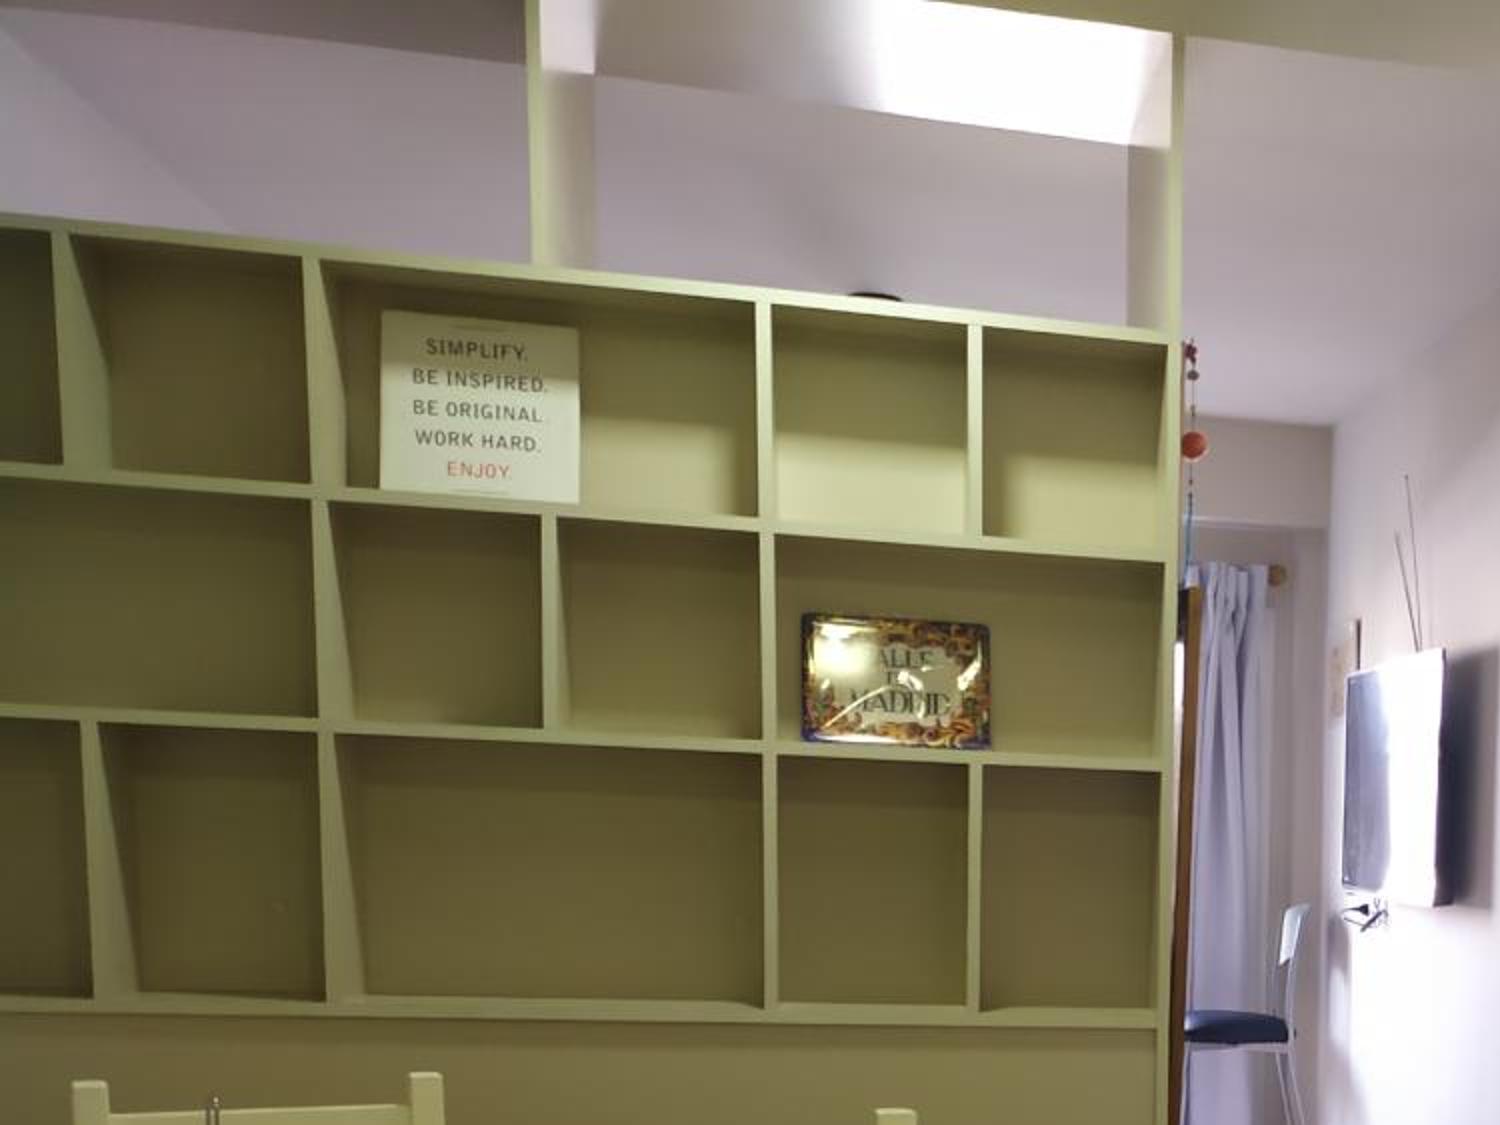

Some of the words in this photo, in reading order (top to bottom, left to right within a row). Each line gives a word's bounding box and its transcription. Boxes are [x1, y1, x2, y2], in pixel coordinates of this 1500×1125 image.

[425, 337, 528, 362] SIMPLIFY.
[412, 367, 439, 385] BE
[413, 399, 439, 416] BE
[414, 429, 474, 447] WORK
